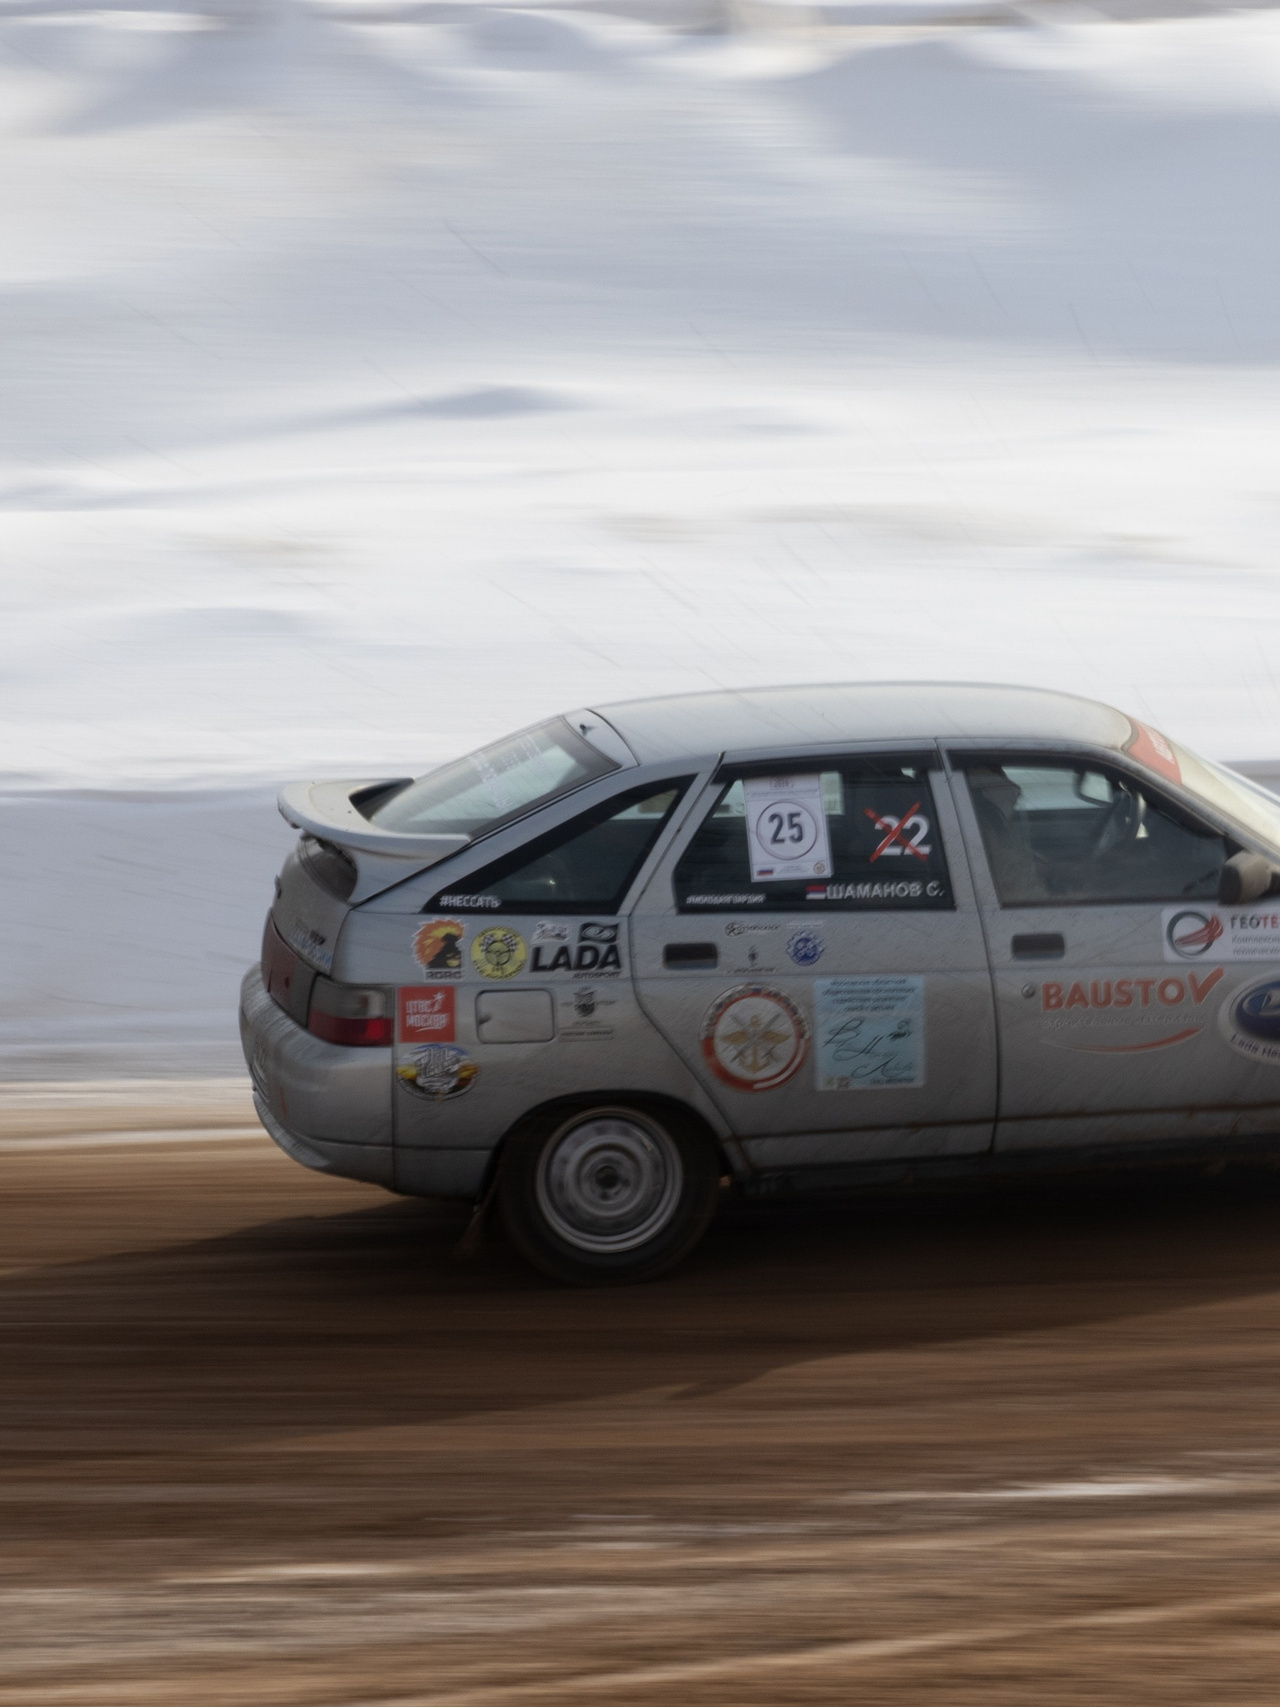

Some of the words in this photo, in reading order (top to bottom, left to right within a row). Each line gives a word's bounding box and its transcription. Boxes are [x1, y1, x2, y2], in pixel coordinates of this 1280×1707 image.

[768, 812, 804, 845] 25
[874, 814, 933, 857] 22
[440, 895, 501, 908] #НЕССАТЬ
[826, 882, 922, 900] ШАМАНОВ
[531, 944, 621, 973] LADA
[572, 971, 622, 980] AUTOSPORT
[1041, 967, 1224, 1012] BAUSTOV
[405, 1013, 449, 1028] МОСКВА
[1230, 1033, 1260, 1054] Lada
